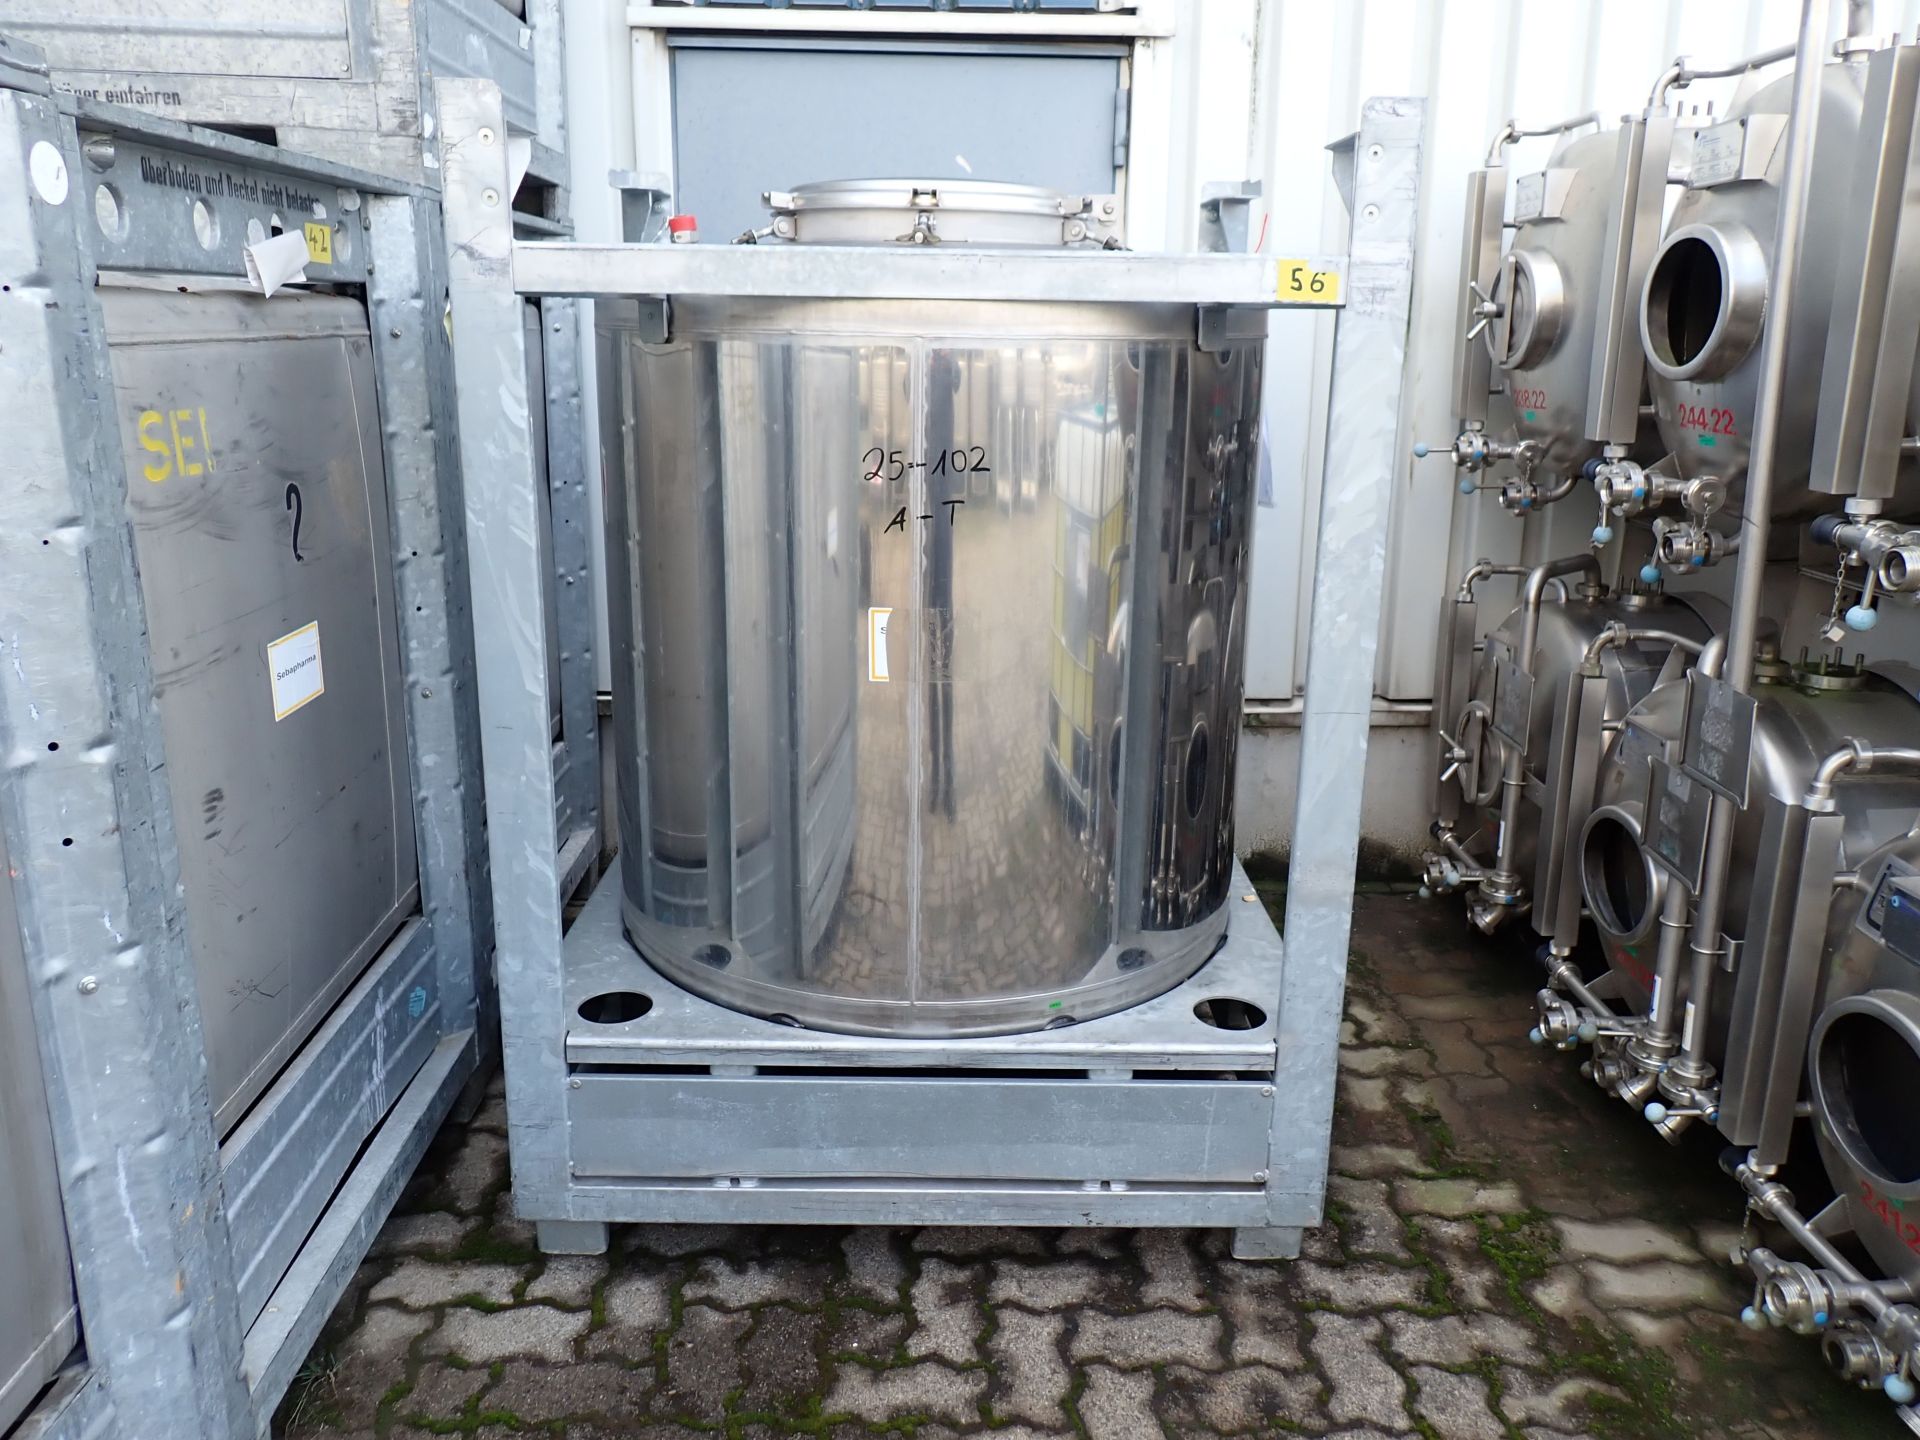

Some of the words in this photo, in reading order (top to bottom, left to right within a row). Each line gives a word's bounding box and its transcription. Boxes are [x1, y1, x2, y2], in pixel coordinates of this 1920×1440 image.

[105, 84, 181, 106] einfahren
[140, 155, 201, 193] Oberboden
[205, 172, 224, 197] und
[226, 173, 259, 204] Deckel
[261, 182, 283, 209] nicht
[309, 227, 328, 254] 42
[1290, 267, 1326, 294] 56
[276, 654, 317, 681] Sebapharma
